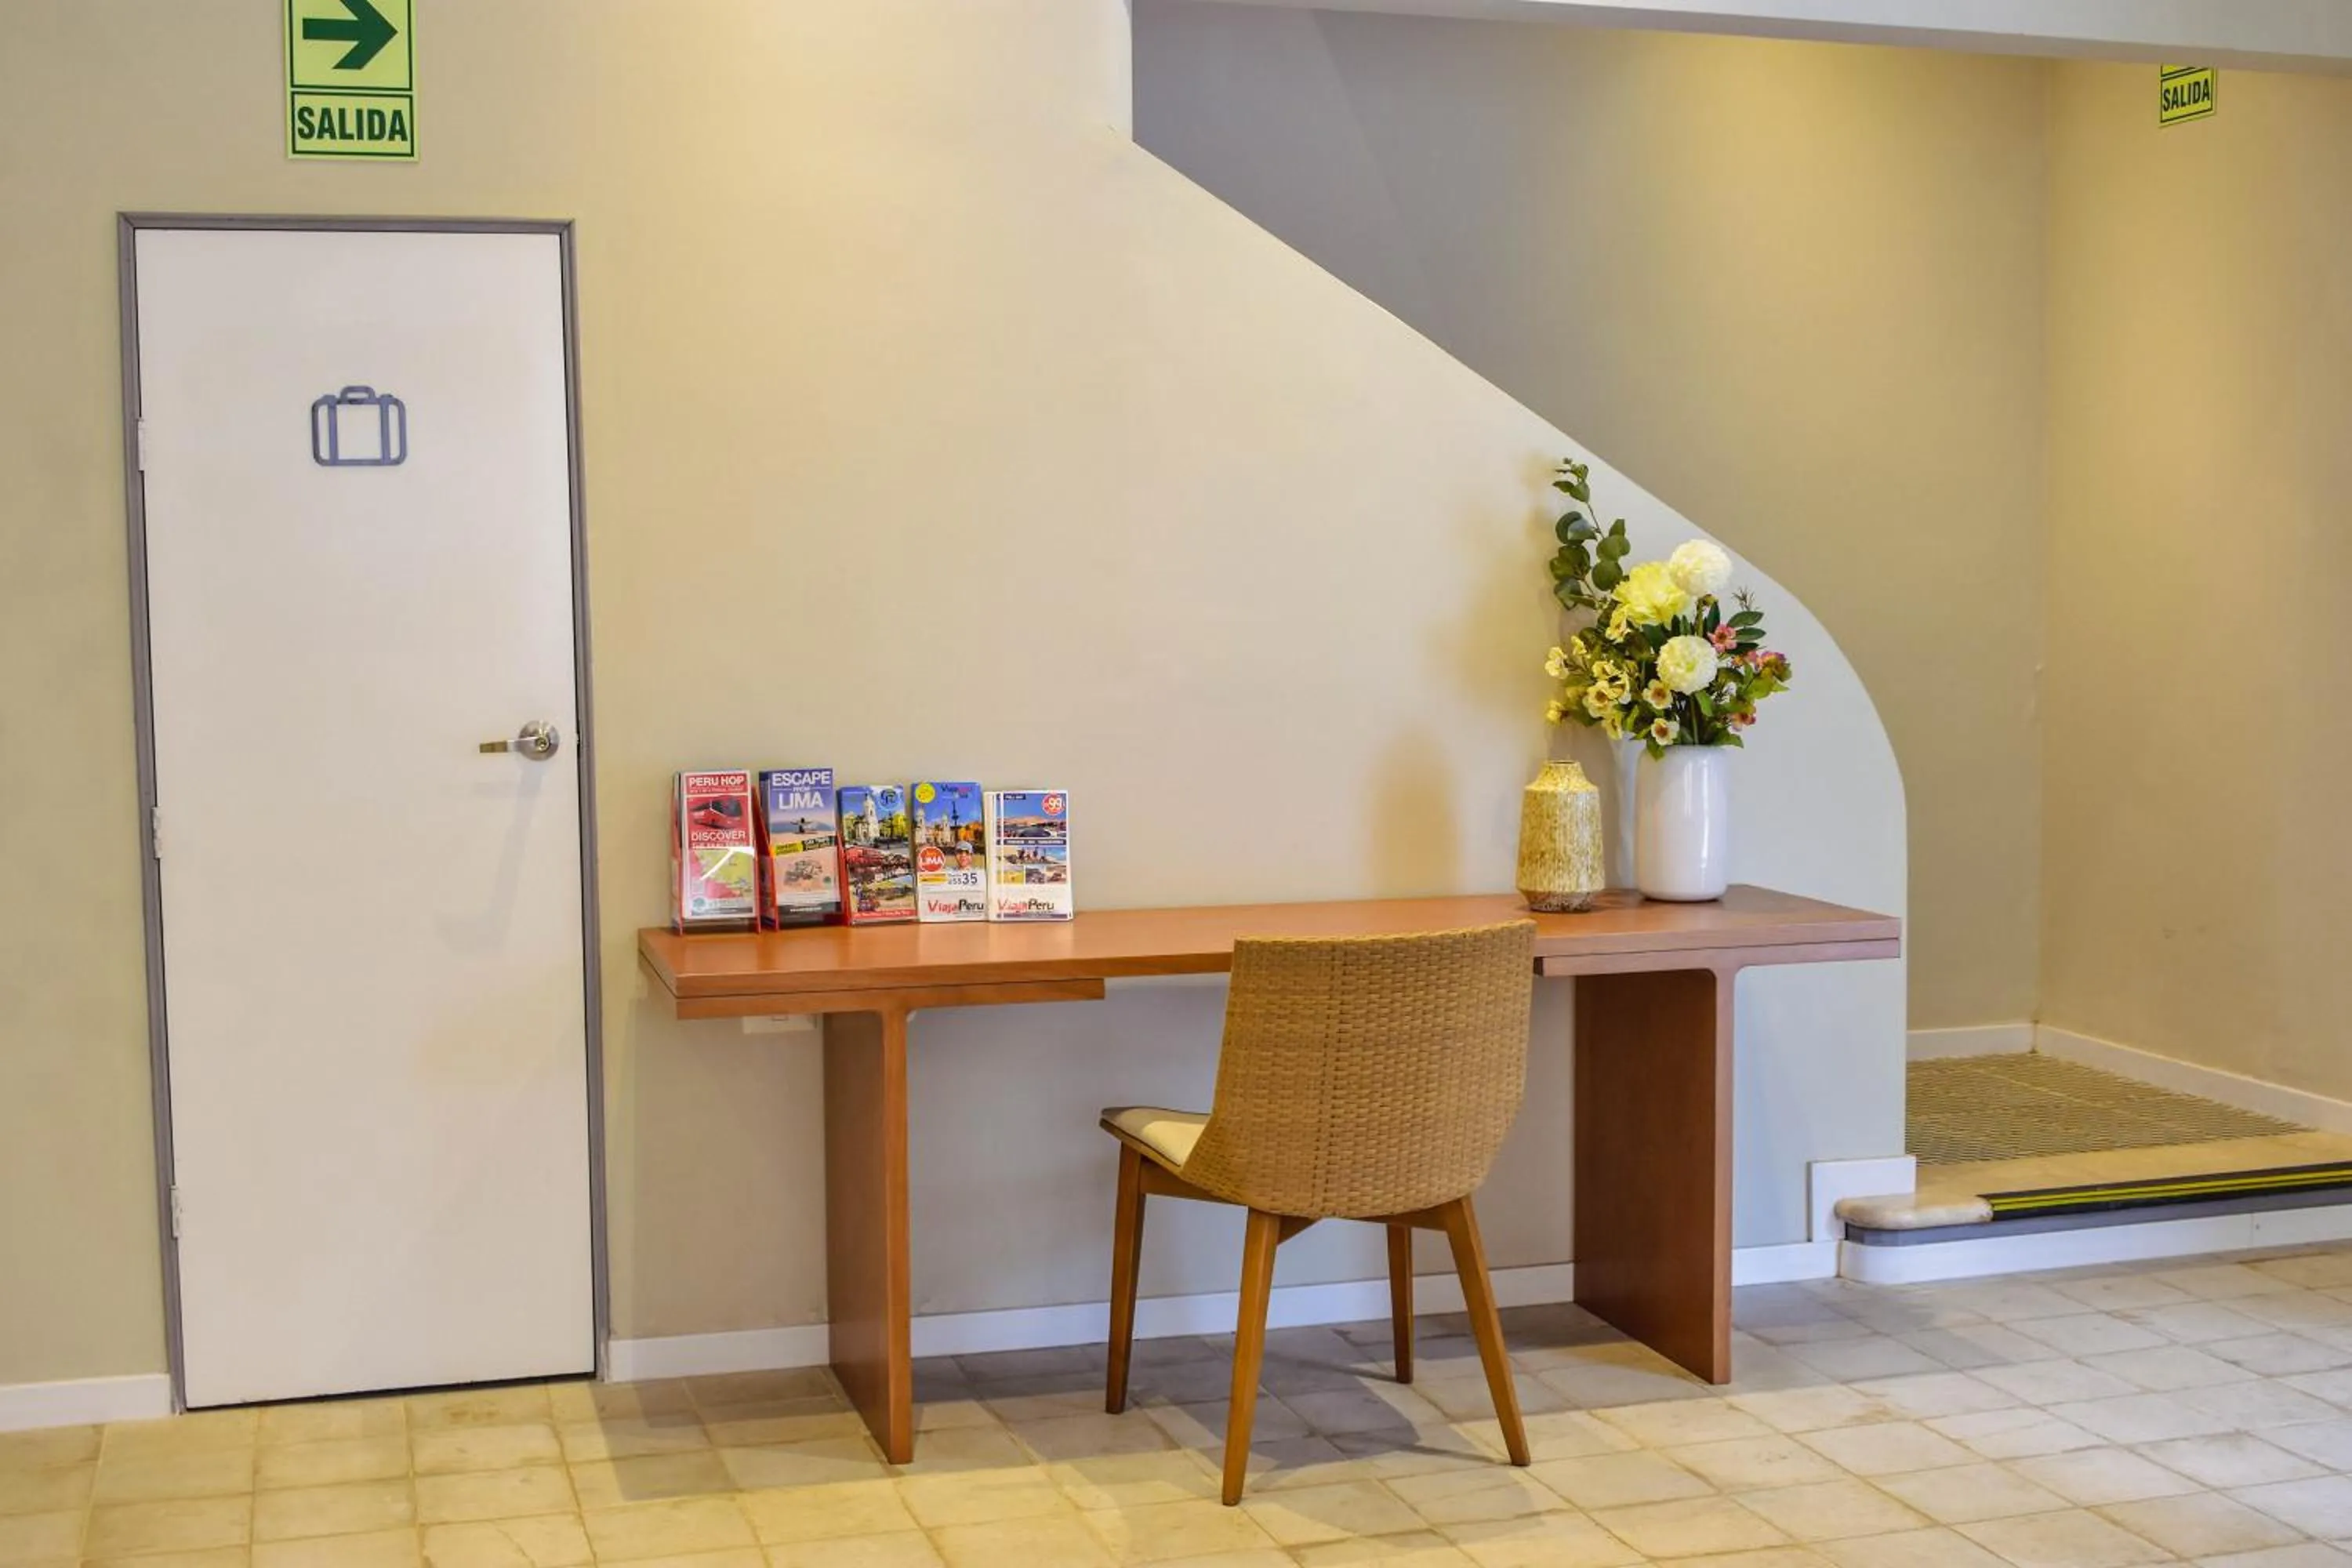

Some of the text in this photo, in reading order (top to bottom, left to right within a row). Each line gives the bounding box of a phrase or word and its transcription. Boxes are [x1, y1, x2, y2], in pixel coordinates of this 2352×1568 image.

[2162, 78, 2210, 112] SALIDA
[297, 106, 408, 142] SALIDA
[689, 775, 744, 786] PERU HOP
[771, 771, 831, 786] ESCAPE
[779, 790, 825, 810] LIMA
[691, 830, 746, 841] DISCOVER
